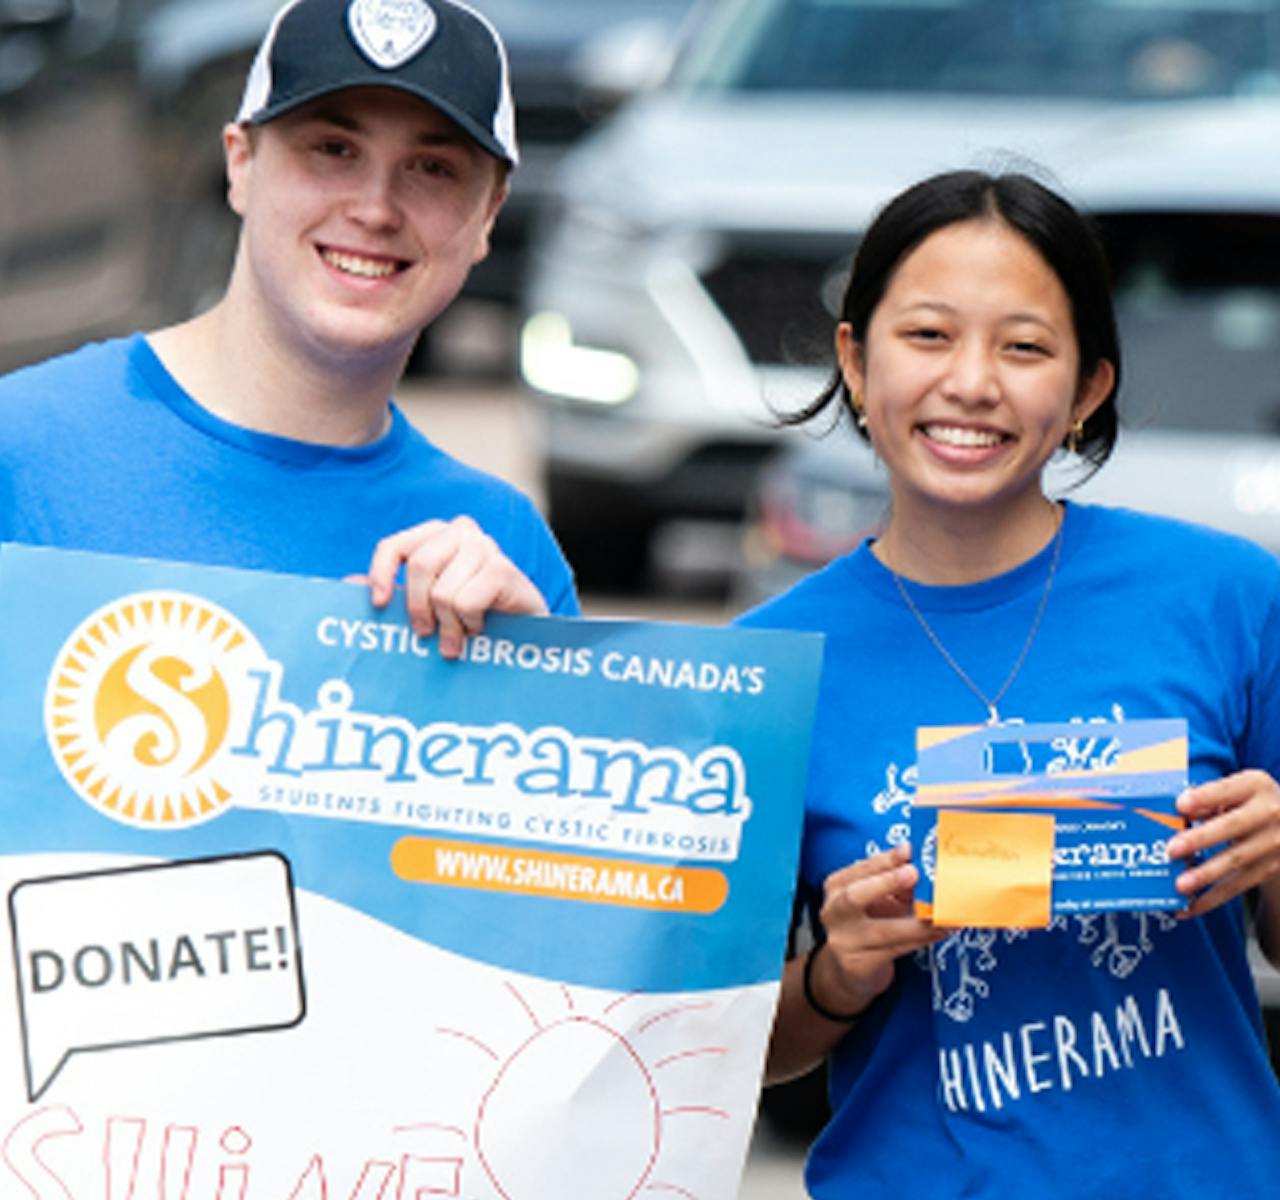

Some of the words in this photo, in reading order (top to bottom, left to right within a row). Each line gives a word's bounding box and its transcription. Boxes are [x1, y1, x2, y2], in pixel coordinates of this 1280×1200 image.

[458, 636, 592, 677] IBROSIS
[601, 652, 765, 695] CANADA'S
[105, 638, 743, 816] Shinerama
[258, 785, 381, 815] STUDENTS
[393, 800, 512, 830] FIGHTING
[524, 815, 609, 842] CYSTIC
[622, 827, 732, 855] FIBROSIS
[434, 848, 685, 904] WWW.SHINERAMA.CA
[29, 926, 288, 993] DONATE!
